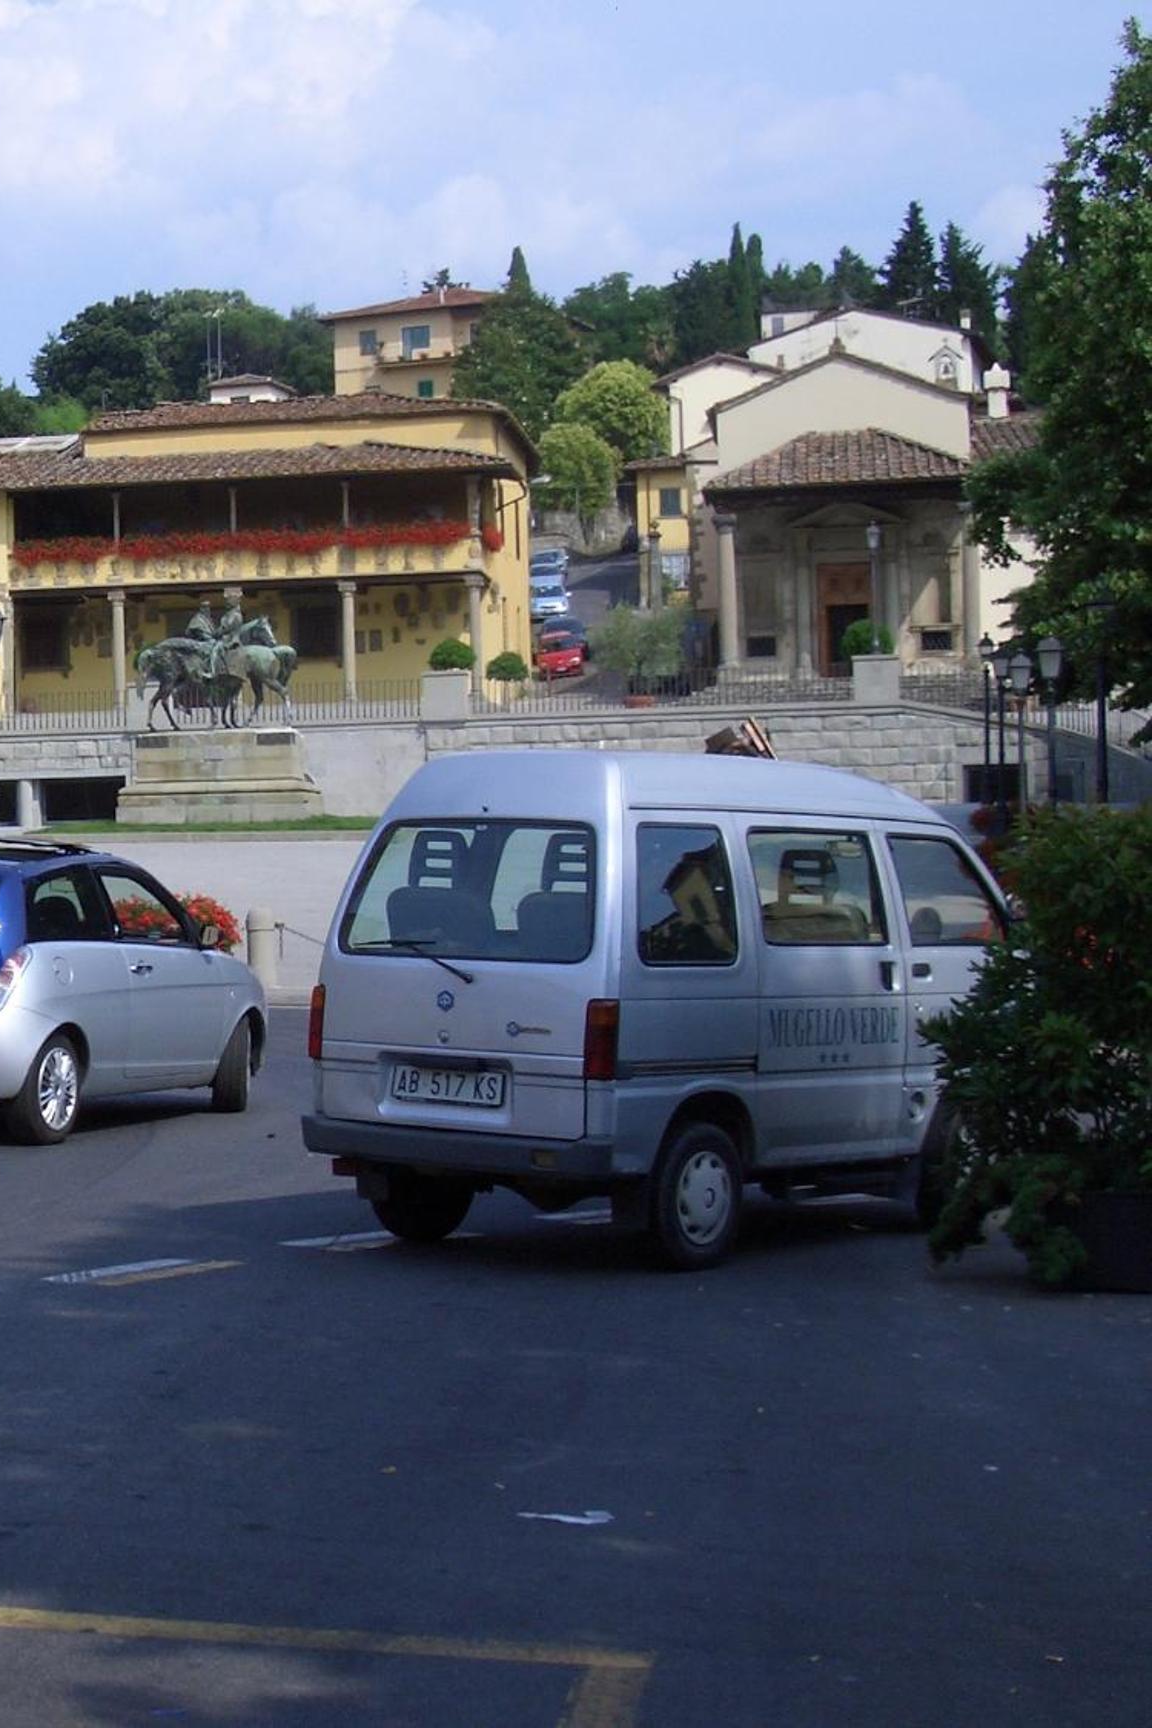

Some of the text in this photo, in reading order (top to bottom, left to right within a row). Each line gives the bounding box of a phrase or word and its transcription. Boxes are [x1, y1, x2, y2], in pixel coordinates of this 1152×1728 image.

[769, 1007, 900, 1047] MUGELLO VERDE
[397, 1069, 498, 1100] AB 517 KS
